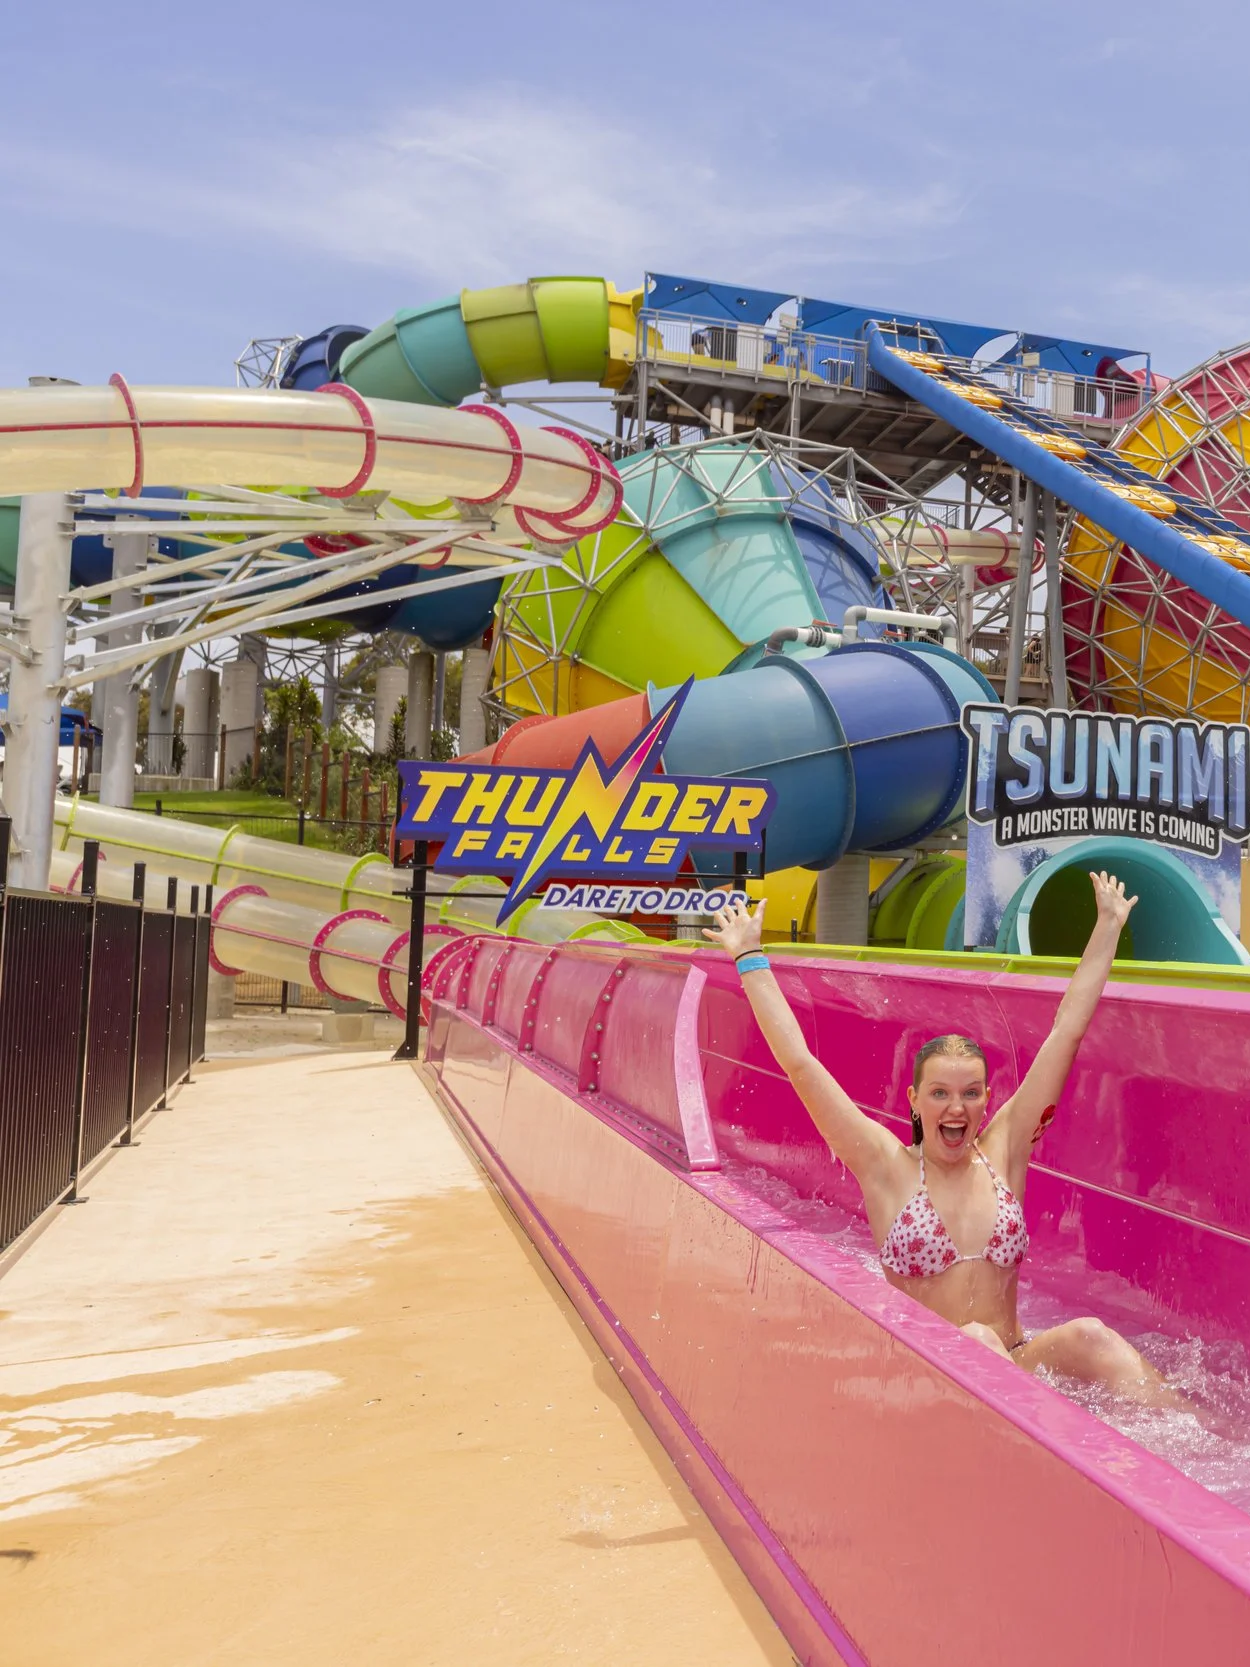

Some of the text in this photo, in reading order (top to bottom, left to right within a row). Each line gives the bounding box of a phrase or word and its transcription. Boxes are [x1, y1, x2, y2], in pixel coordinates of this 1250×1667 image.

[969, 709, 1246, 833] TSUNAMI
[452, 829, 680, 865] FALLS
[1001, 807, 1215, 849] A MONSTER WAVE IS COMING
[543, 887, 622, 909] DARE
[626, 889, 661, 911] TO
